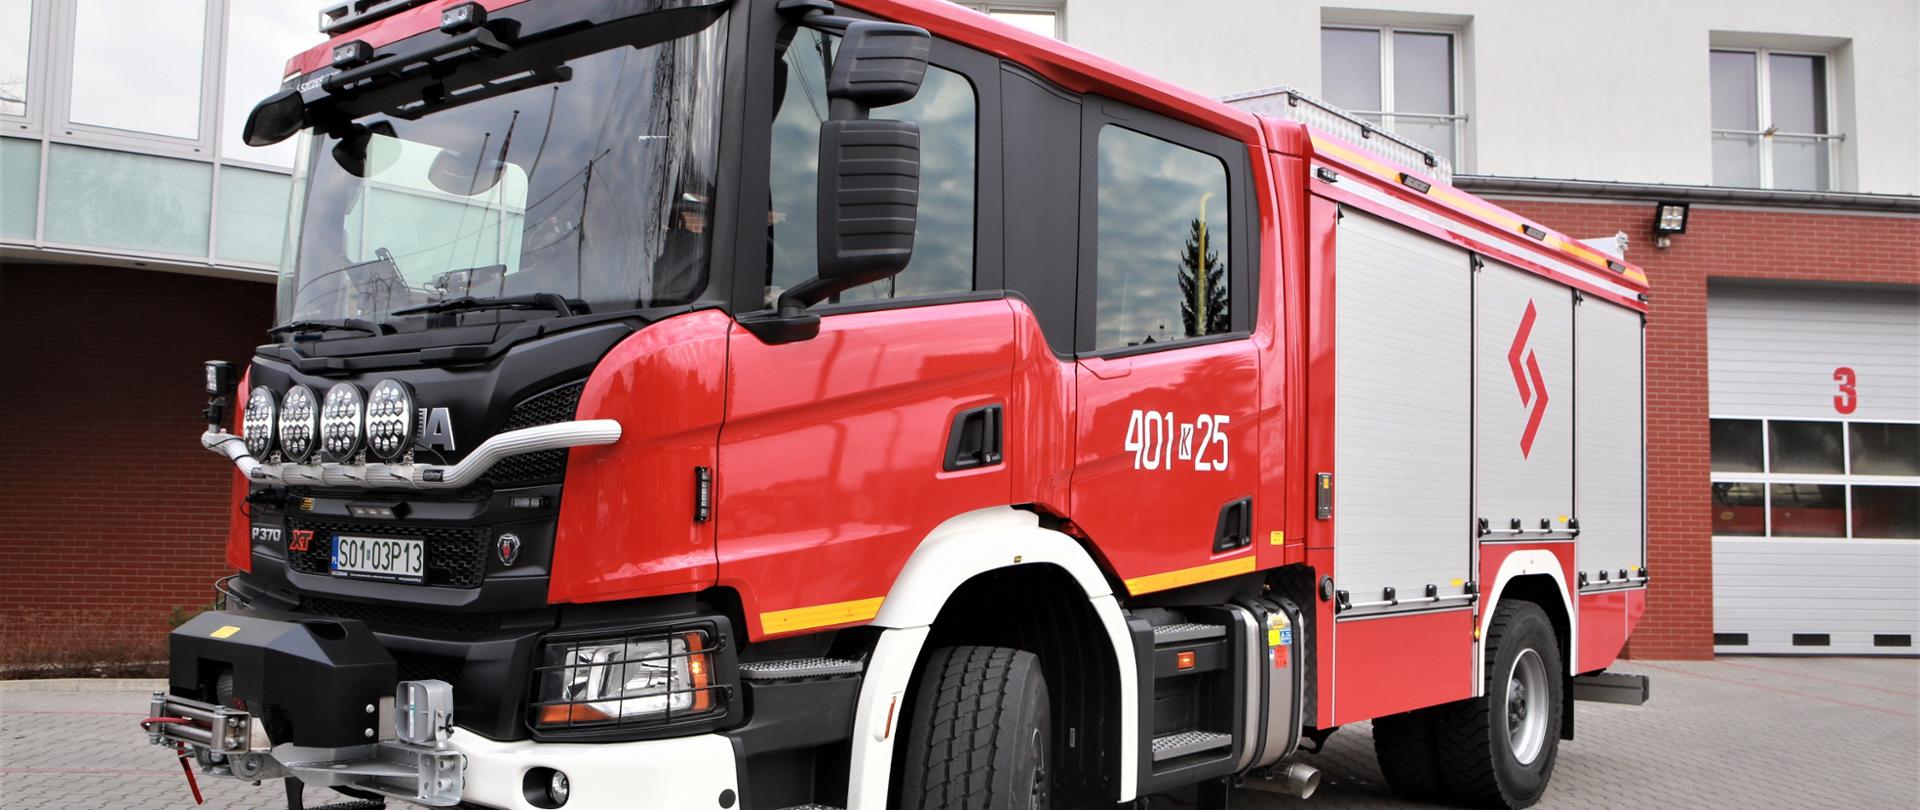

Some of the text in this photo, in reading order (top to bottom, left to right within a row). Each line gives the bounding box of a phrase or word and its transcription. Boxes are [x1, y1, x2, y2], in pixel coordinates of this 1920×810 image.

[1833, 366, 1857, 415] 3
[1125, 409, 1174, 471] 401
[1194, 413, 1230, 471] 25
[289, 530, 314, 551] XT
